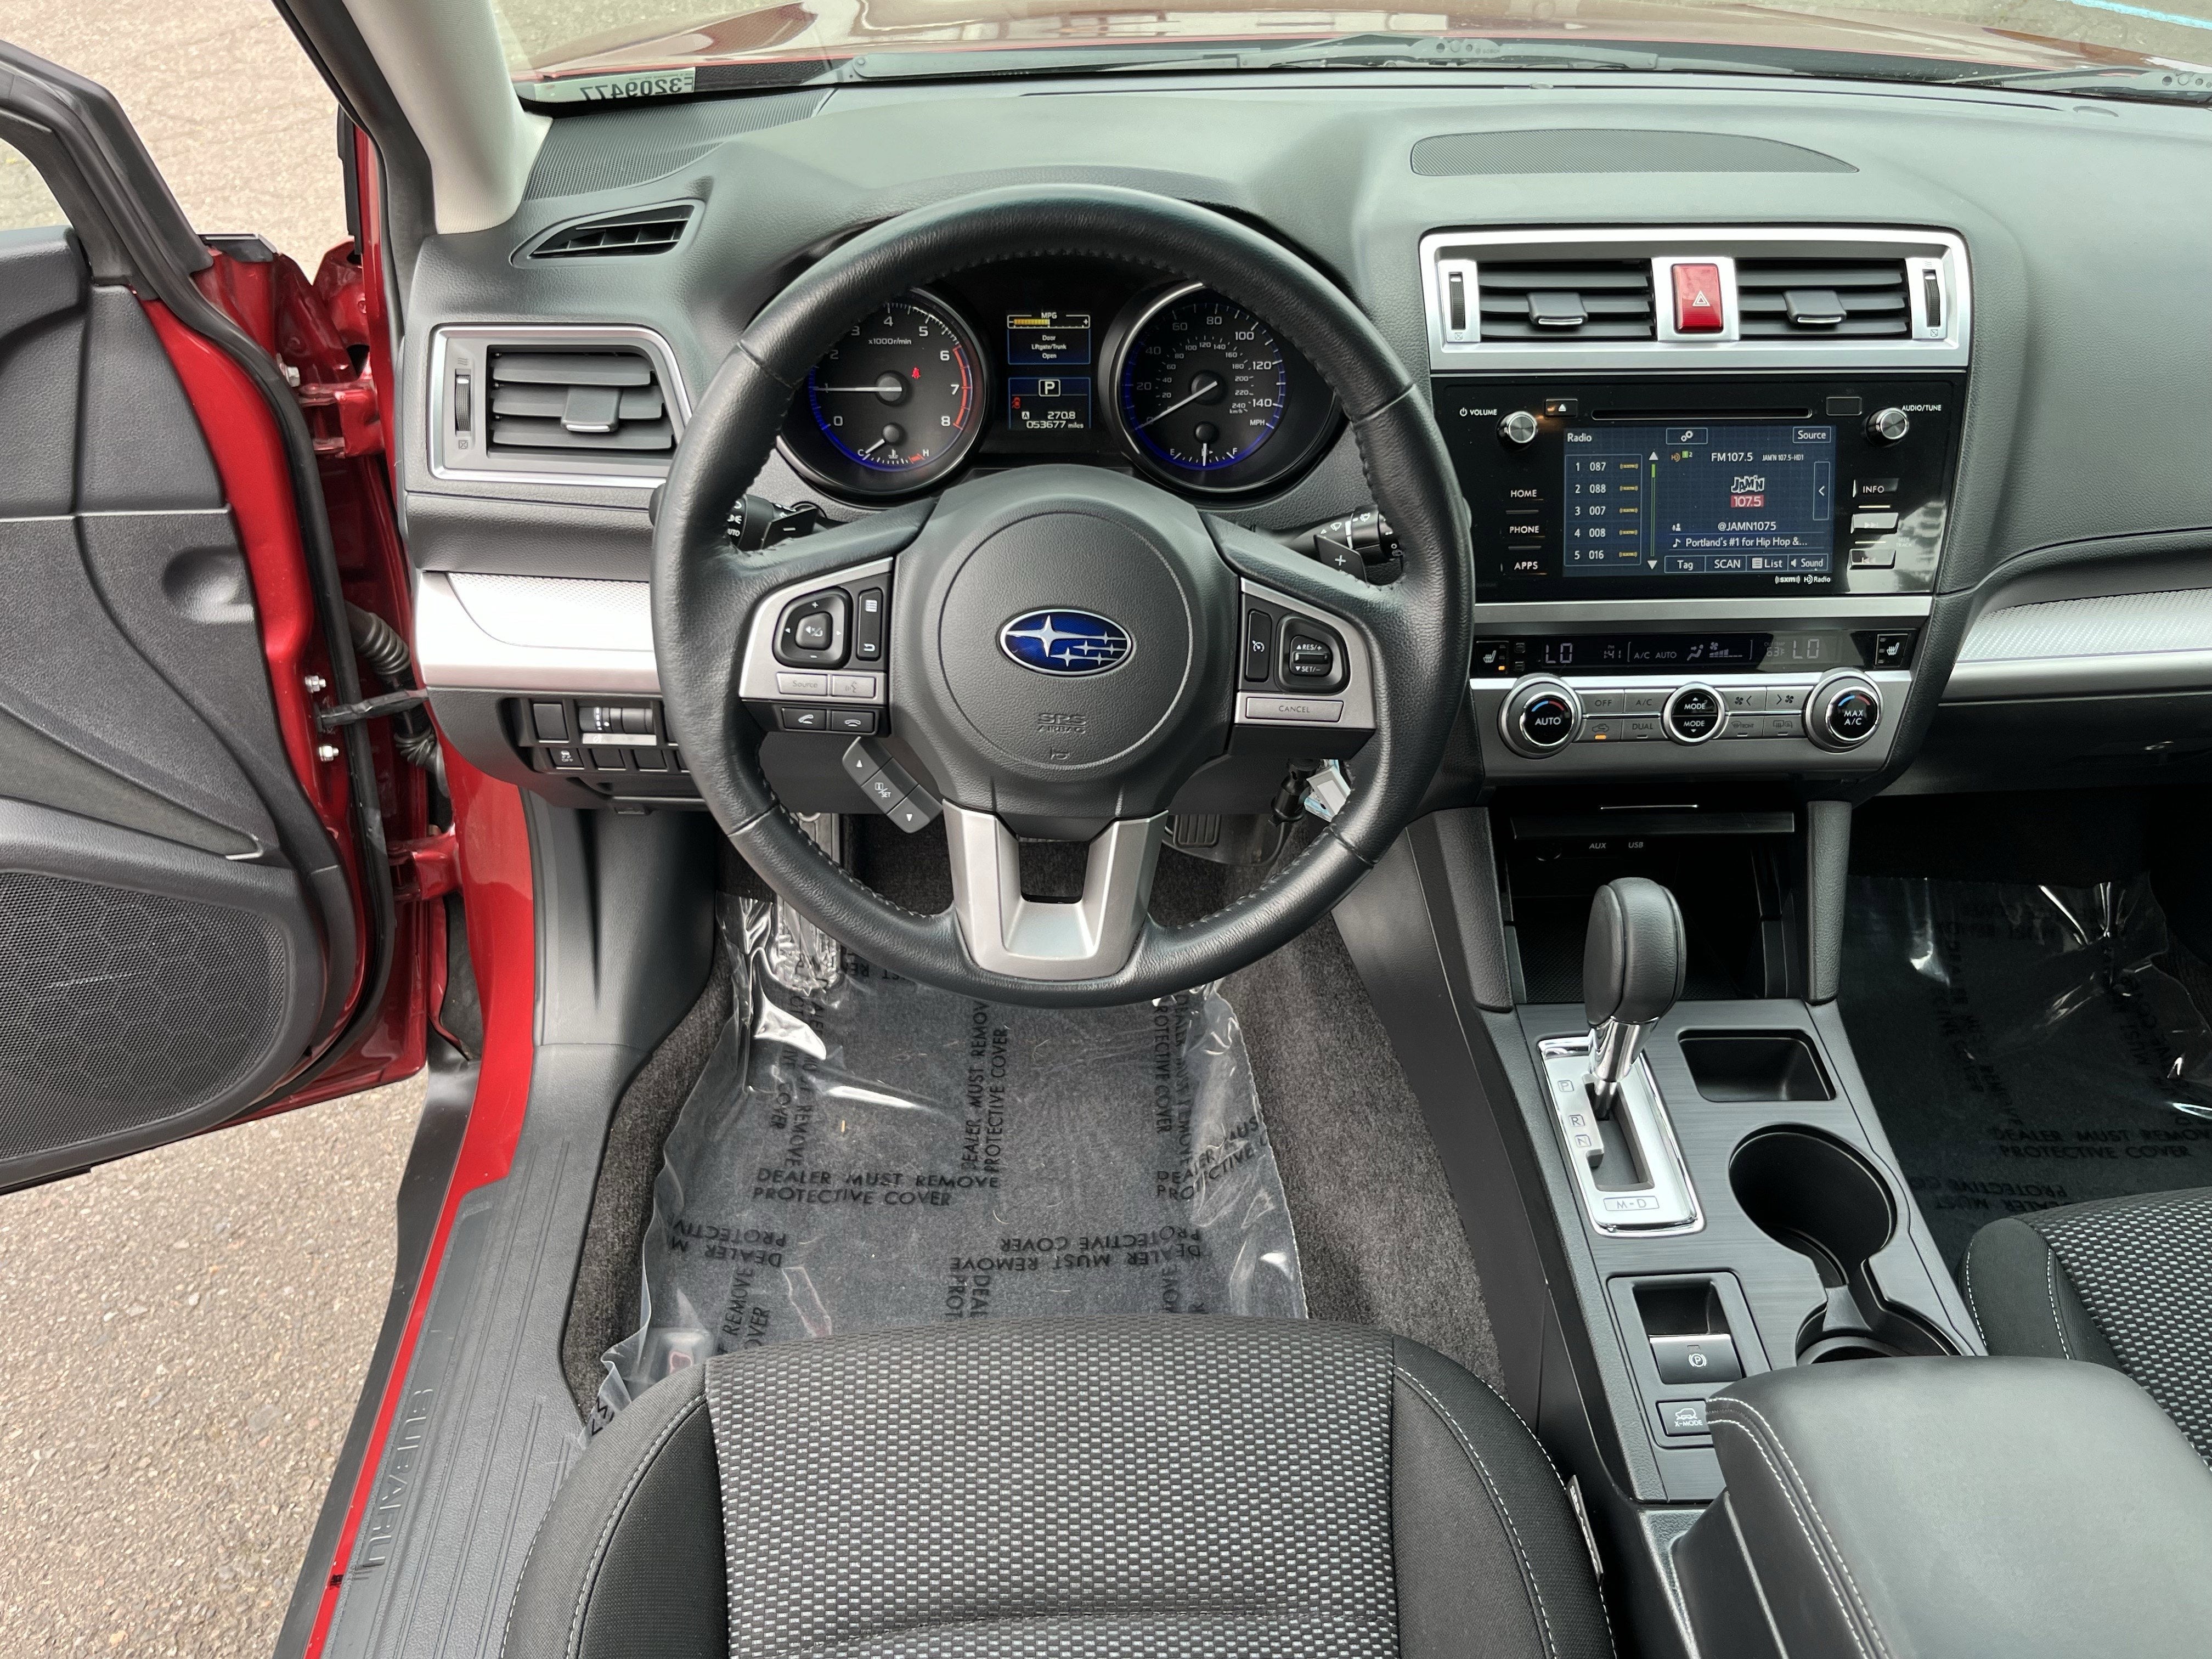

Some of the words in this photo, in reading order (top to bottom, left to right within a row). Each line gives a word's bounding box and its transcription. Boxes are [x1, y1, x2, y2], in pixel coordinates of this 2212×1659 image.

[883, 316, 893, 326] 4
[1206, 317, 1222, 325] 80
[851, 326, 860, 336] 3
[918, 326, 929, 337] 5
[1235, 331, 1254, 340] 100
[830, 349, 839, 360] 2
[1146, 346, 1161, 354] 40
[940, 350, 950, 361] 6
[1252, 361, 1272, 370] 120
[951, 383, 960, 395] 7
[1044, 381, 1055, 395] P
[1136, 382, 1152, 390] 20
[1252, 399, 1272, 407] 140
[833, 416, 843, 426] 0
[941, 416, 951, 426] 8
[1026, 421, 1066, 429] 053677
[1567, 433, 1592, 442] Radio
[1797, 430, 1826, 440] Source
[1576, 462, 1580, 471] 1
[1590, 462, 1606, 471] 087
[1510, 489, 1537, 498] HOME
[1575, 484, 1581, 493] 2
[1590, 484, 1606, 493] 088
[1863, 485, 1884, 493] INFO
[1734, 496, 1762, 507] 107.5
[1575, 506, 1581, 515] 3
[1589, 506, 1606, 515] 007
[1510, 526, 1539, 534] PHONE
[1718, 522, 1776, 532] @JAMN1075
[1575, 529, 1581, 538] 4
[1589, 528, 1606, 537] 008
[1686, 538, 1727, 547] Portland's
[1729, 537, 1740, 546] #1
[1741, 537, 1754, 546] for
[1756, 537, 1770, 548] Hip
[1773, 537, 1790, 547] Hop
[1575, 551, 1580, 560] 5
[1589, 550, 1604, 559] 016
[1514, 561, 1538, 570] APPS
[1677, 560, 1694, 571] Tag
[1714, 560, 1741, 568] SCAN
[1764, 558, 1783, 568] List
[1801, 558, 1824, 568] Sound
[792, 680, 818, 689] Source
[1535, 716, 1562, 726] AUTO
[971, 1001, 988, 1065] REMOV
[1154, 1006, 1170, 1081] ROTECTIVE
[991, 1026, 1007, 1078] COVER
[967, 1075, 983, 1109] MUST
[1155, 1085, 1172, 1134] COVER
[984, 1082, 1005, 1173] PROTECTIVE
[785, 1104, 812, 1167] REMOVE
[961, 1118, 982, 1171] DEALER
[758, 1167, 831, 1186] DEALER
[845, 1172, 904, 1187] MUST
[915, 1175, 1000, 1189] REMOVE
[753, 1186, 873, 1205] PROTECTIVE
[884, 1190, 951, 1206] COVER
[1001, 1237, 1069, 1252] COVER
[704, 1244, 783, 1268] DEALER
[951, 1255, 1039, 1272] REMOVE
[1052, 1254, 1110, 1270] MUST
[722, 1268, 754, 1336] REMOVE
[744, 1307, 770, 1350] OVER
[1674, 1419, 1703, 1427] X-MODE
[364, 1388, 434, 1567] SUBARU
